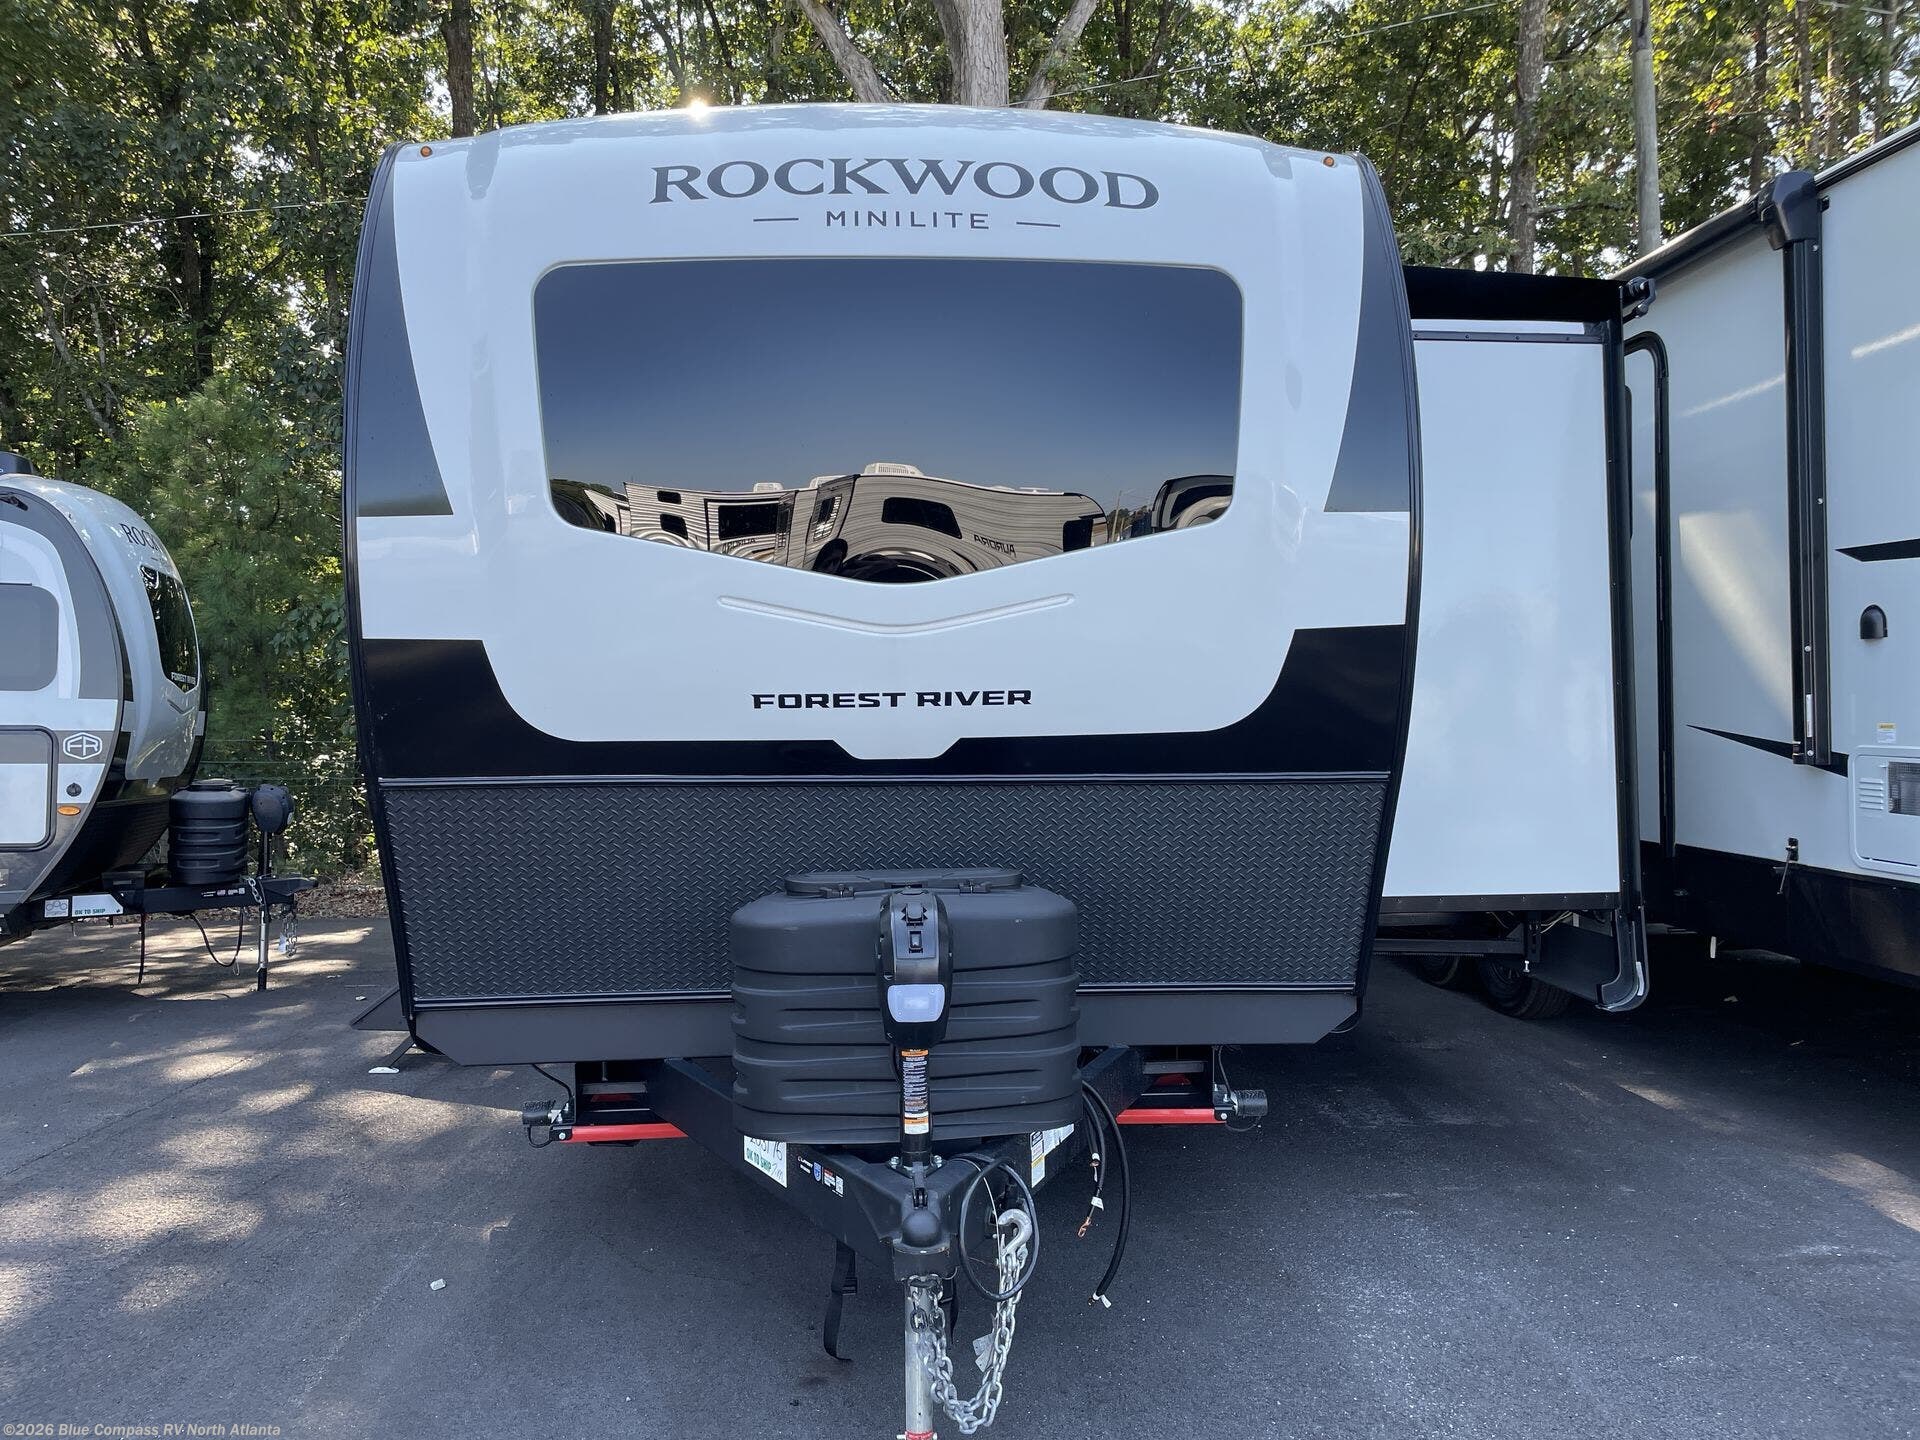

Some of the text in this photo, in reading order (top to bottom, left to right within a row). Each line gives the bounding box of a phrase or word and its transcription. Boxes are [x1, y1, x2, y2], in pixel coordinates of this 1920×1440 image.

[649, 157, 1159, 209] ROCKWOOD
[826, 210, 989, 230] MINILITE
[751, 690, 1032, 709] FOREST RIVER
